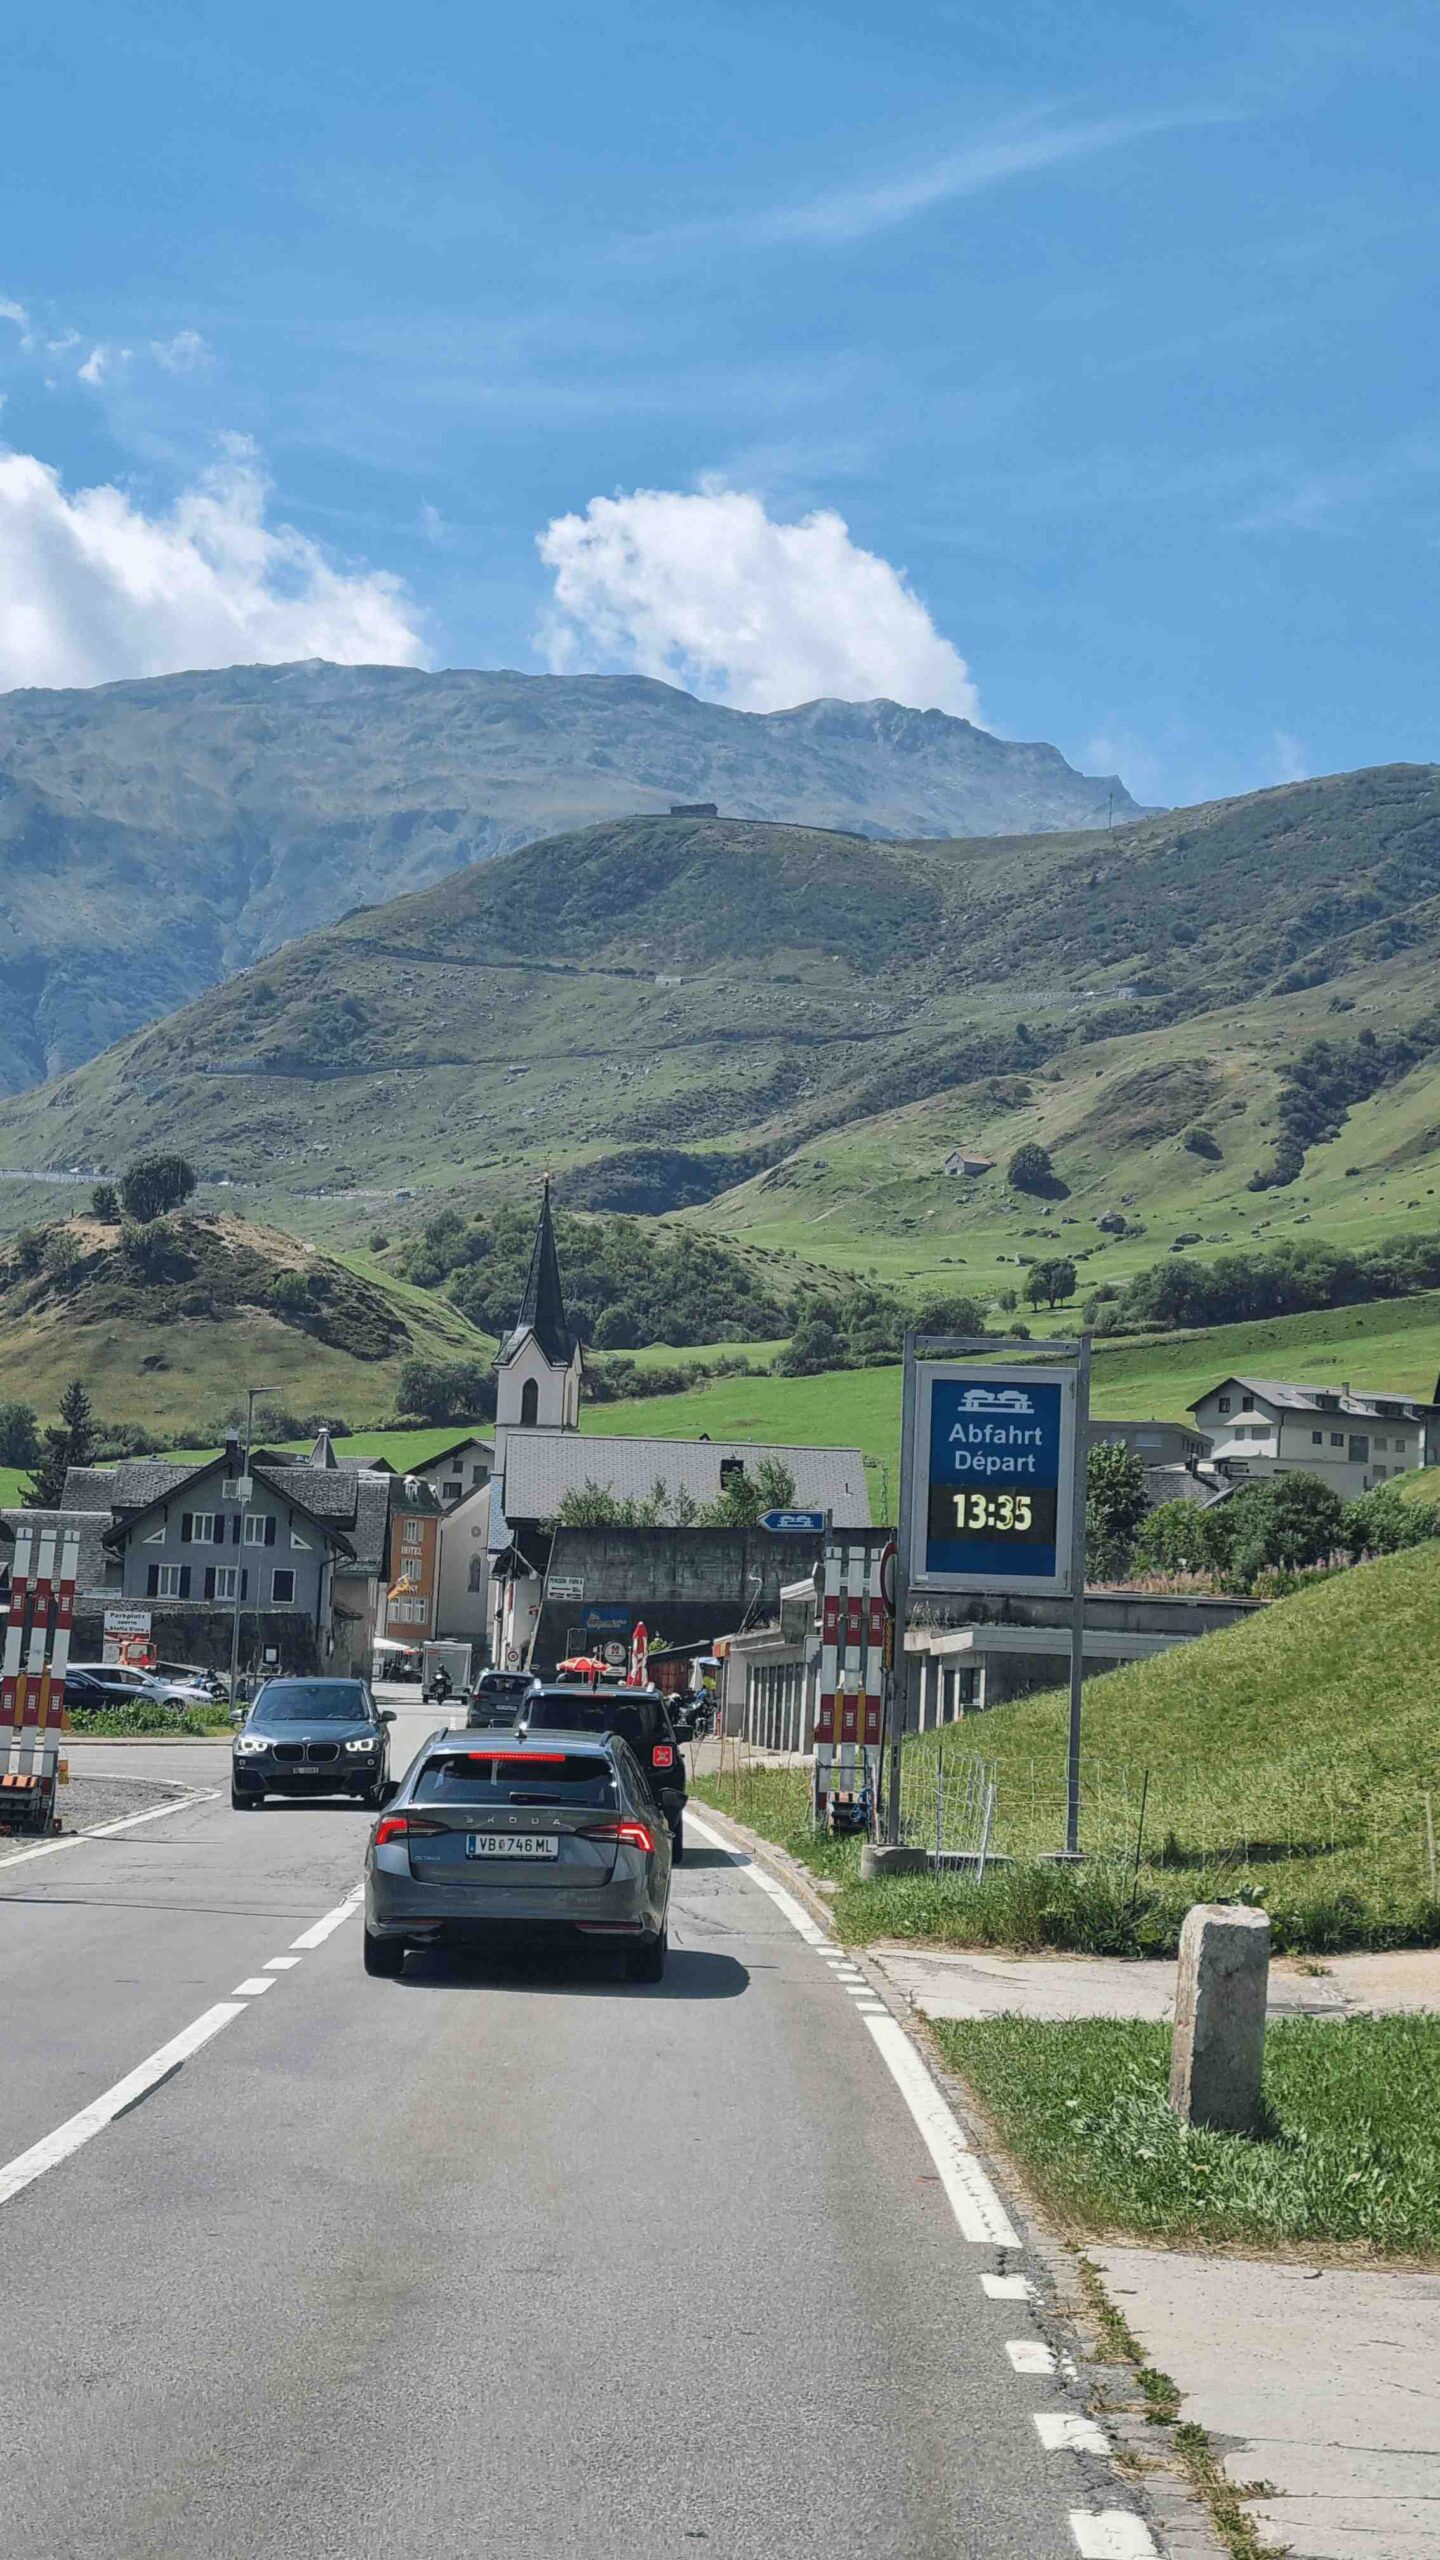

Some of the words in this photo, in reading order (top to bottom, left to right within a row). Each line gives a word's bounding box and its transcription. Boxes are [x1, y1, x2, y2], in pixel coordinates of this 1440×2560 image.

[948, 1423, 1042, 1445] Abfahrt
[955, 1450, 1035, 1475] Départ
[953, 1494, 1032, 1530] 13:35
[401, 1545, 423, 1556] HOTEL
[110, 1612, 145, 1620] Parkplatz
[479, 1838, 496, 1851] VB
[507, 1838, 533, 1852] 746
[536, 1839, 552, 1853] ML
